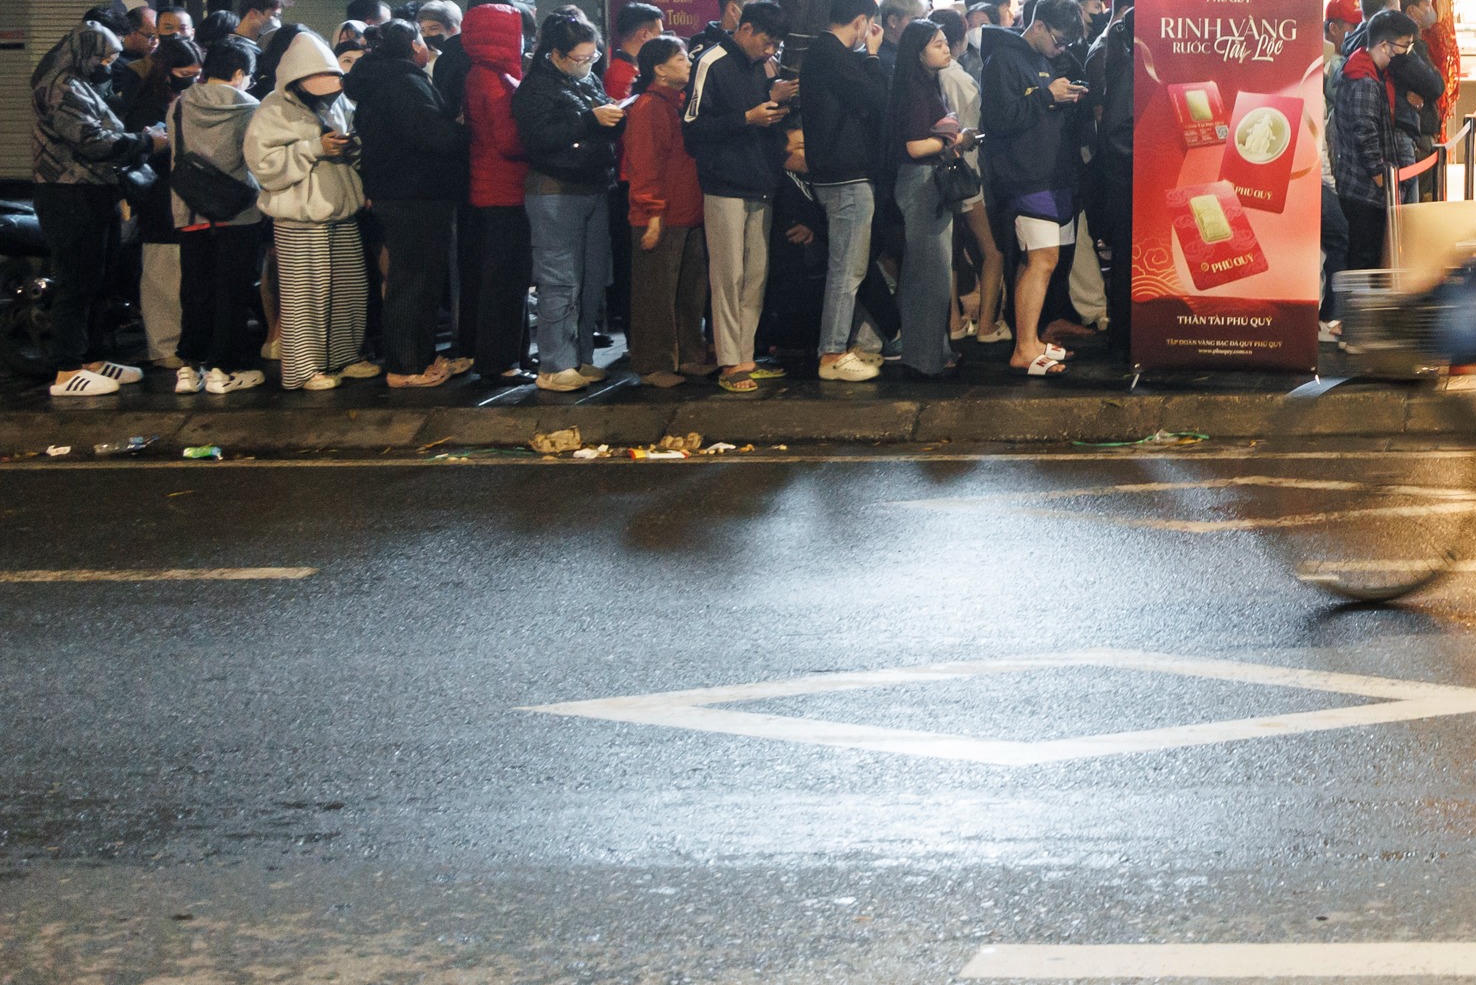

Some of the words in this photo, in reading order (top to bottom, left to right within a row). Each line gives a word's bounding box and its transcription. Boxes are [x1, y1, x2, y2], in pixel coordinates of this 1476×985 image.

[1160, 17, 1221, 39] RINH
[1229, 14, 1297, 41] VÀNG
[1177, 314, 1206, 326] THẦN
[1208, 314, 1225, 326] TÀI
[1226, 315, 1248, 327] PHÚ
[1250, 315, 1273, 328] QUÝ
